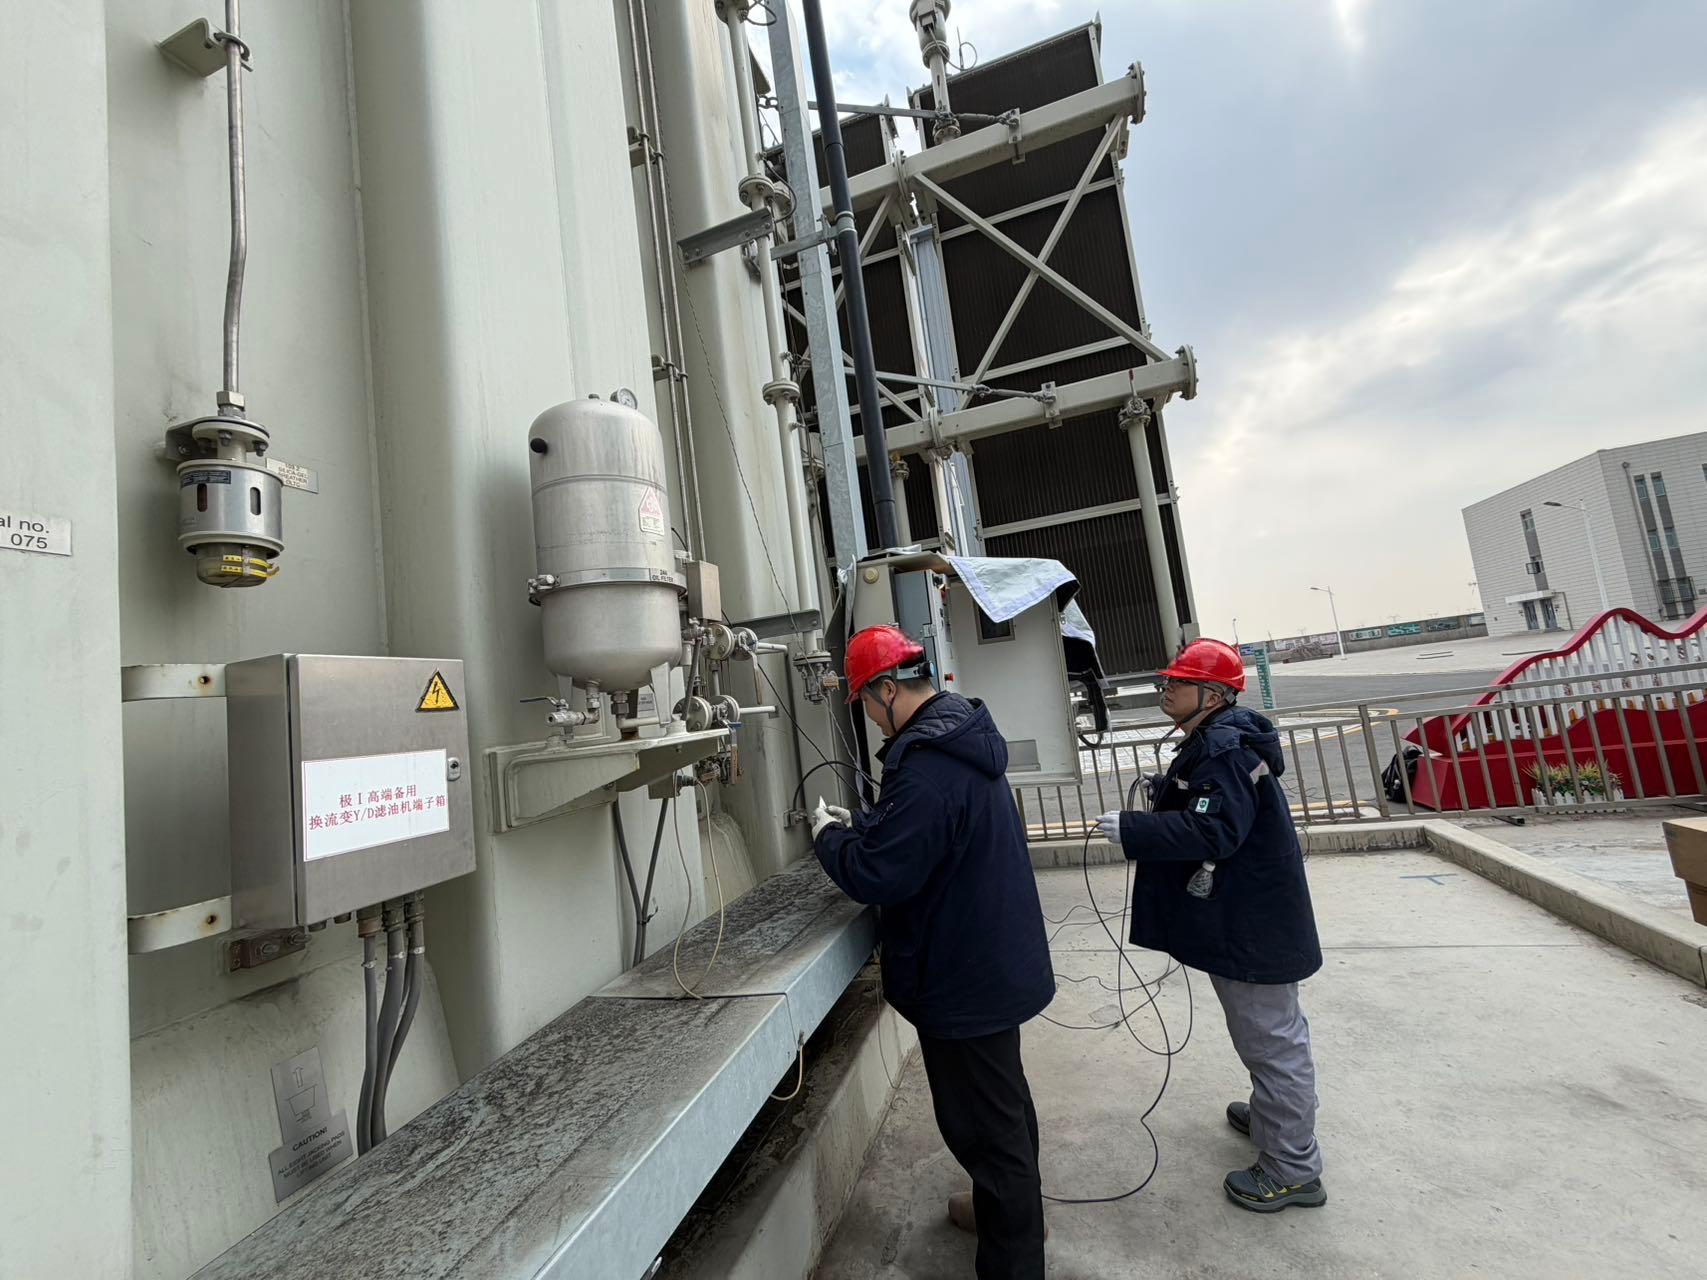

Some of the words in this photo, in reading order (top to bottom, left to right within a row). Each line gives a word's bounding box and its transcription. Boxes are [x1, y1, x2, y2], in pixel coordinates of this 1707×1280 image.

[20, 520, 50, 533] no.
[11, 533, 48, 549] 075
[309, 794, 447, 831] 换流变Y/D滤油机端子箱
[293, 1126, 328, 1151] CAUTION!
